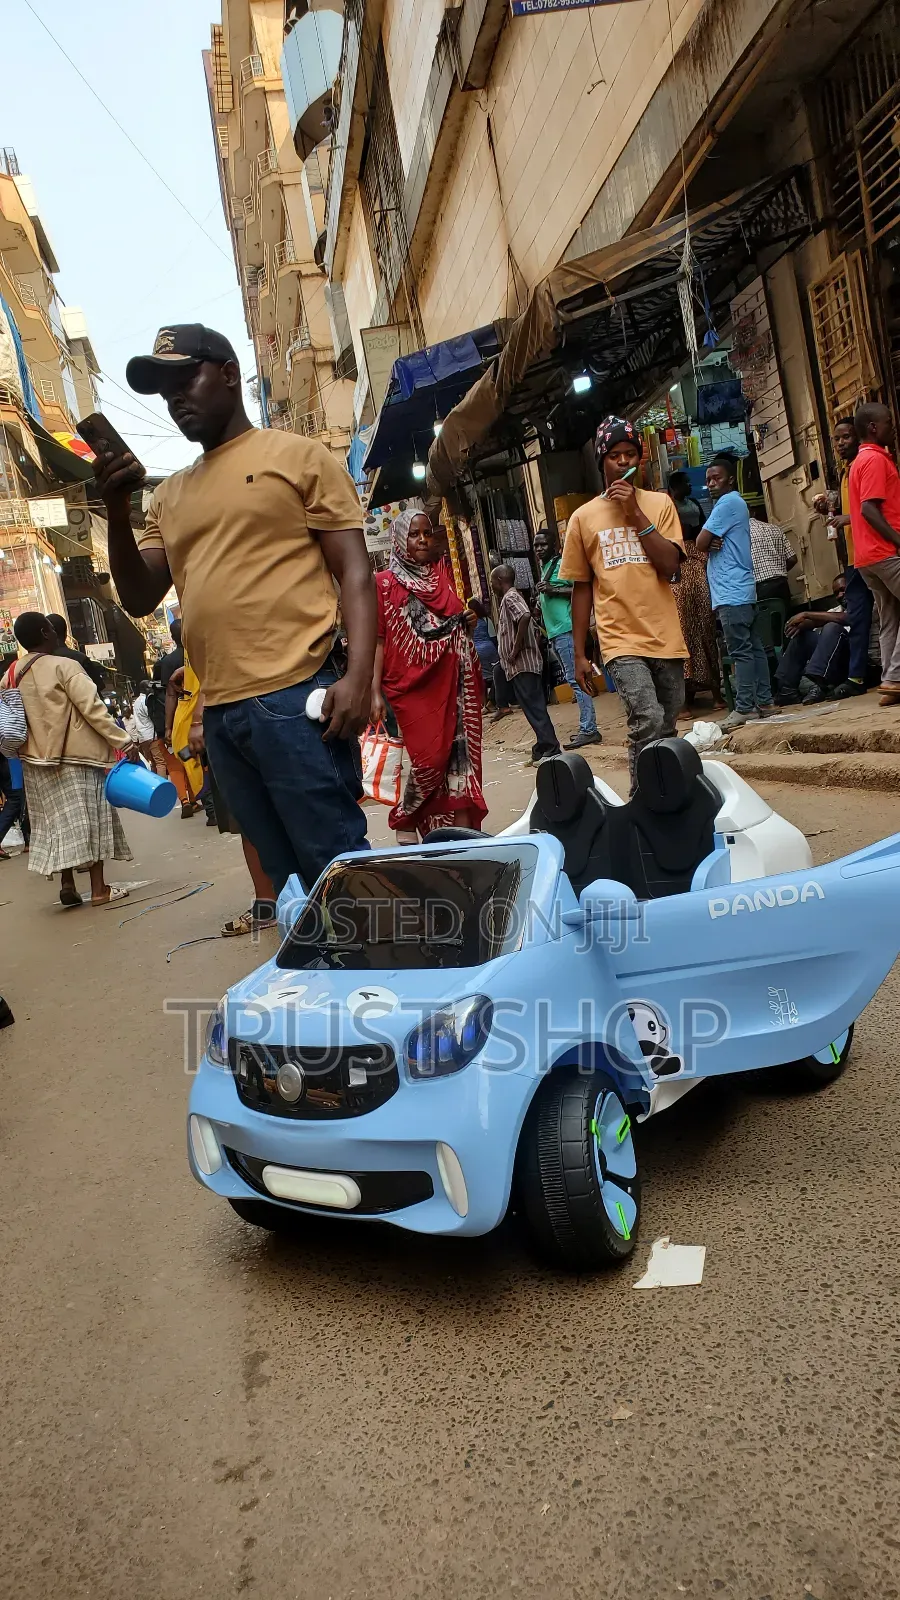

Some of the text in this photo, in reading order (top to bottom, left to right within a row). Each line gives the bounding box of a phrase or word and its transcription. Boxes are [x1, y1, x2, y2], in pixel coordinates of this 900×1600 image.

[597, 526, 639, 547] KEE
[602, 542, 643, 559] GOIN
[708, 881, 825, 920] PANDA
